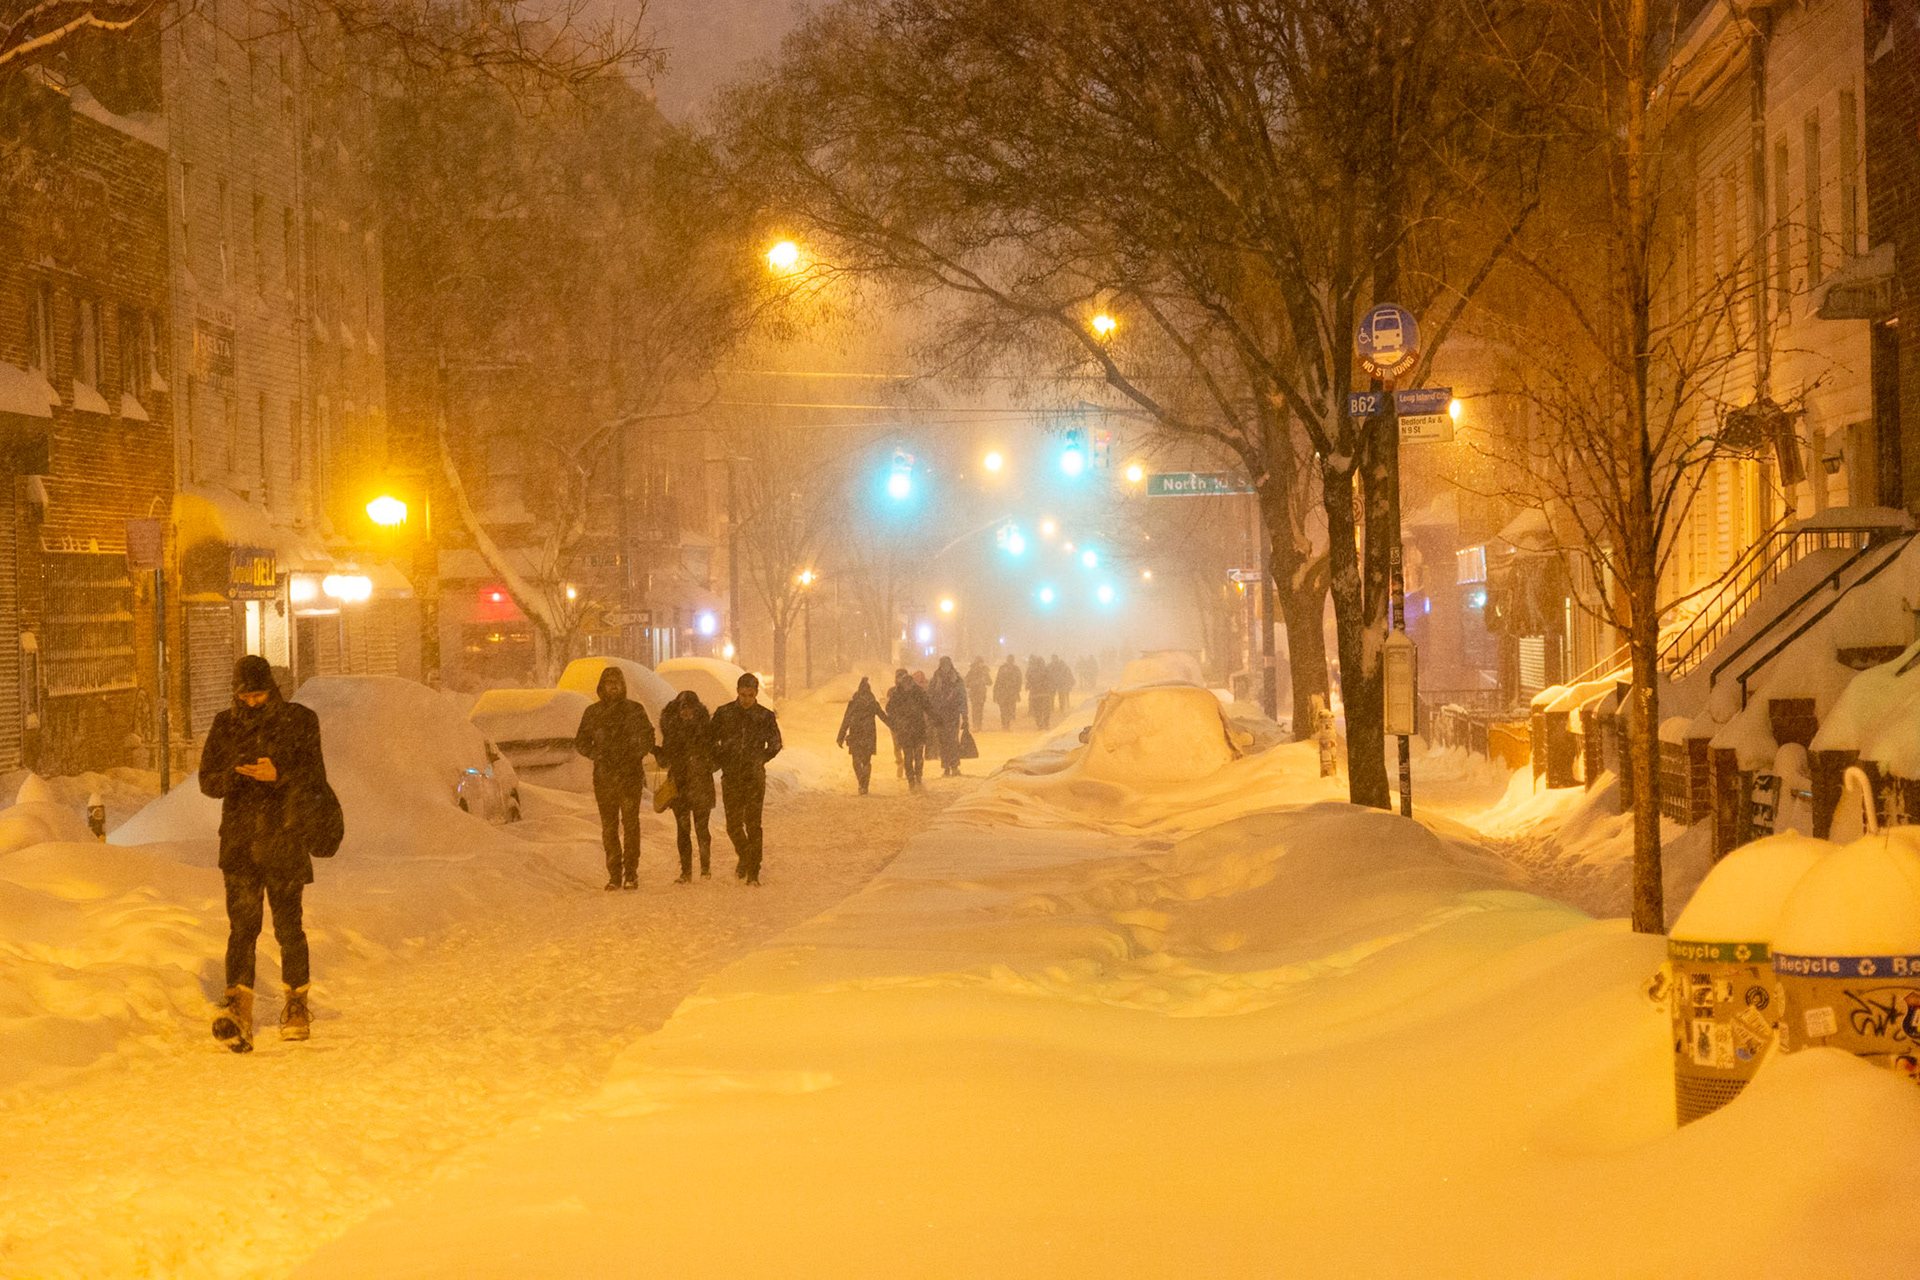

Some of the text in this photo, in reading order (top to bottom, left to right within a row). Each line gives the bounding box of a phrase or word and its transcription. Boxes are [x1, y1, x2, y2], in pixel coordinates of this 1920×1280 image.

[1362, 355, 1415, 377] NO STNDING
[1351, 396, 1376, 413] B62
[1399, 394, 1415, 403] Long
[1416, 392, 1435, 402] Island
[1401, 416, 1443, 426] Bedford Av &
[1413, 426, 1421, 434] St
[1163, 478, 1207, 490] North
[253, 557, 276, 586] DELI
[1669, 940, 1721, 959] Recycle
[1779, 956, 1840, 974] Recycle
